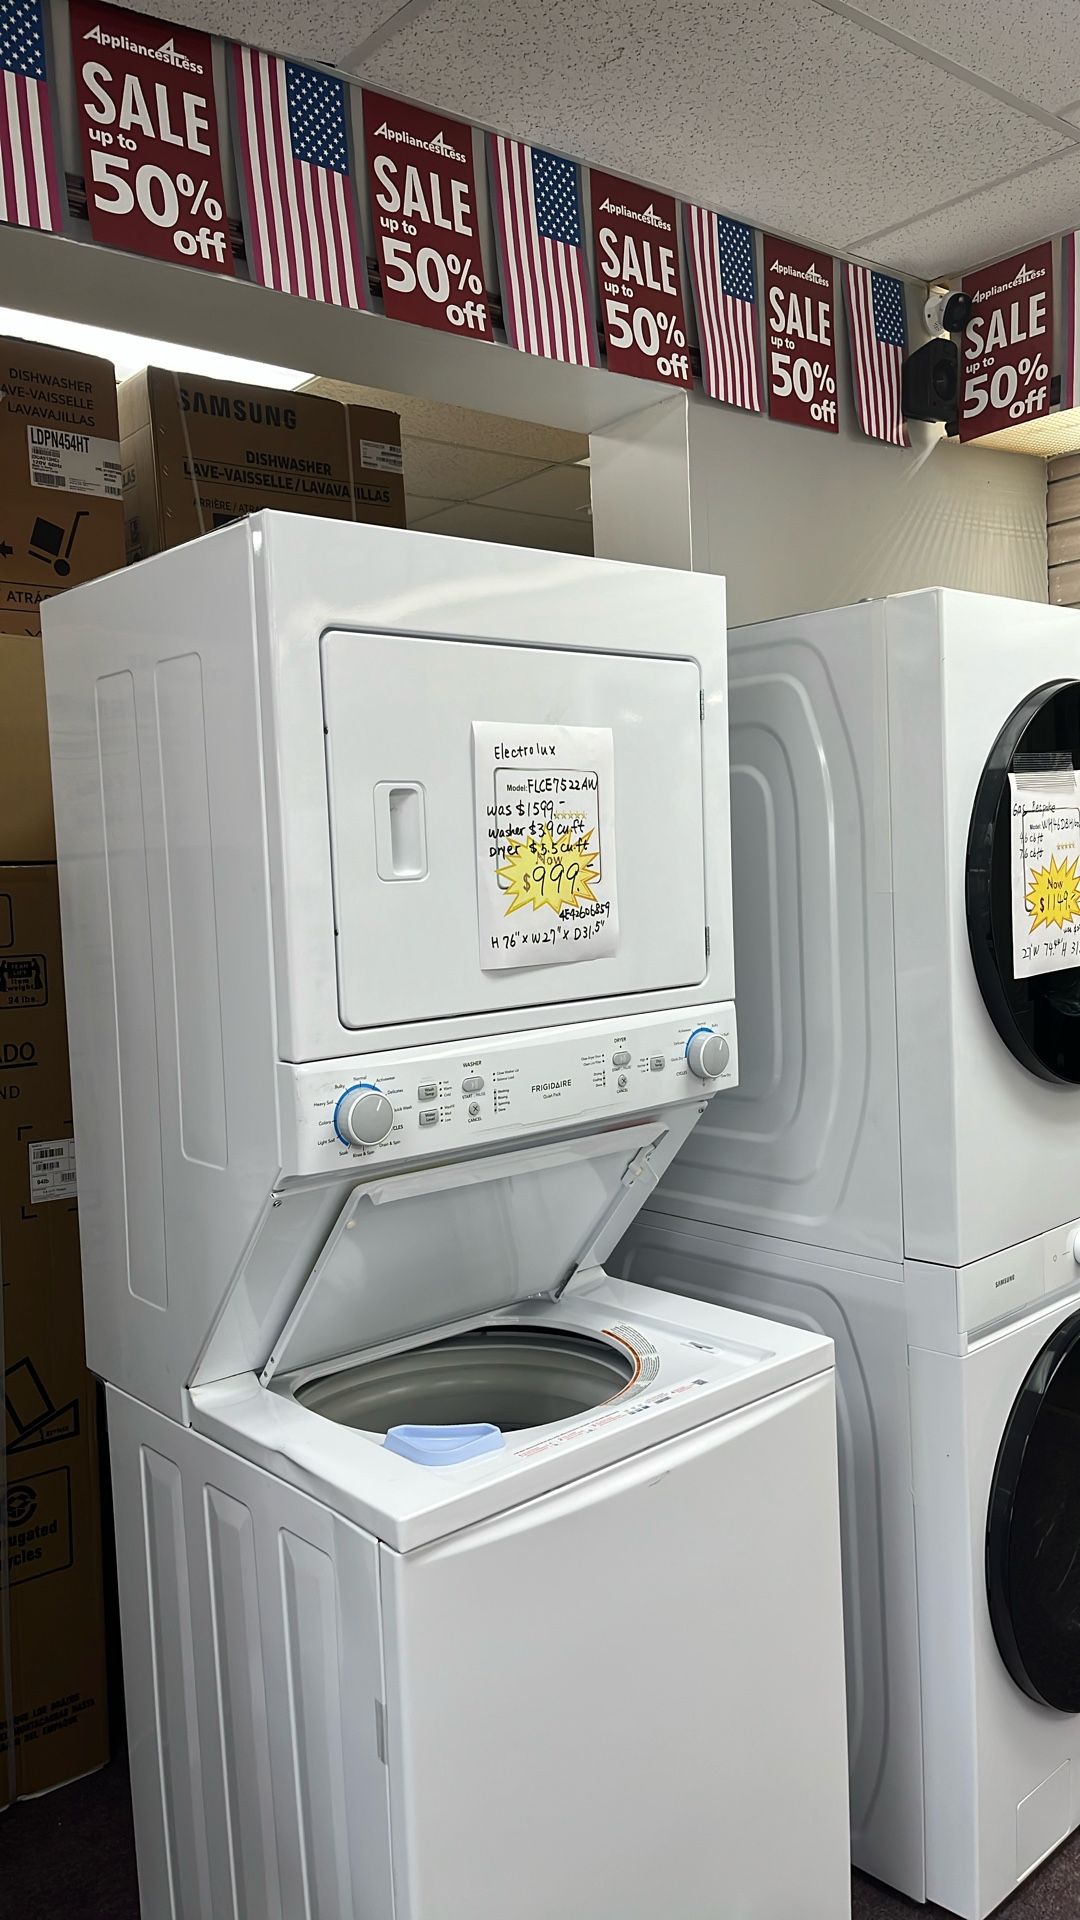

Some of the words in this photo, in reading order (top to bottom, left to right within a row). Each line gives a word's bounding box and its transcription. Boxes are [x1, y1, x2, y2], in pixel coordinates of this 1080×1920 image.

[82, 61, 211, 156] SALE
[88, 128, 114, 147] up
[117, 133, 137, 151] to
[90, 149, 223, 228] 50%
[373, 155, 473, 237] SALE
[380, 216, 399, 233] up
[401, 220, 417, 236] to
[173, 227, 226, 263] off
[382, 235, 483, 303] 50%
[599, 227, 677, 296] SALE
[604, 281, 619, 296] up
[621, 284, 634, 298] to
[446, 300, 487, 332] off
[605, 298, 686, 356] 50%
[769, 286, 831, 346] SALE
[964, 291, 1046, 360] SALE
[771, 336, 783, 349] up
[784, 337, 795, 350] to
[656, 353, 689, 380] off
[771, 351, 835, 403] 50%
[966, 362, 980, 374] up
[982, 357, 995, 367] to
[9, 368, 93, 393] DISHWASHER
[963, 352, 1049, 419] 50%
[7, 401, 96, 427] LAVAVAJILLAS
[178, 388, 296, 430] SAMSUNG
[810, 399, 836, 424] off
[1009, 386, 1047, 419] off
[30, 427, 90, 453] LDPN454HT
[246, 450, 332, 476] DISHWASHER
[7, 590, 51, 604] ATRÁ
[494, 742, 556, 760] Electrolux
[506, 784, 528, 792] Model:
[527, 777, 598, 794] FLCE7522AW
[486, 805, 512, 816] was
[535, 852, 563, 865] Now
[1047, 878, 1063, 890] Now
[491, 936, 499, 949] H
[0, 1042, 35, 1064] DO
[462, 1060, 482, 1068] WASHER
[531, 1079, 572, 1093] FRIGIDAIRE
[995, 1274, 1015, 1288] SAMSUNG
[8, 1519, 57, 1547] ugated
